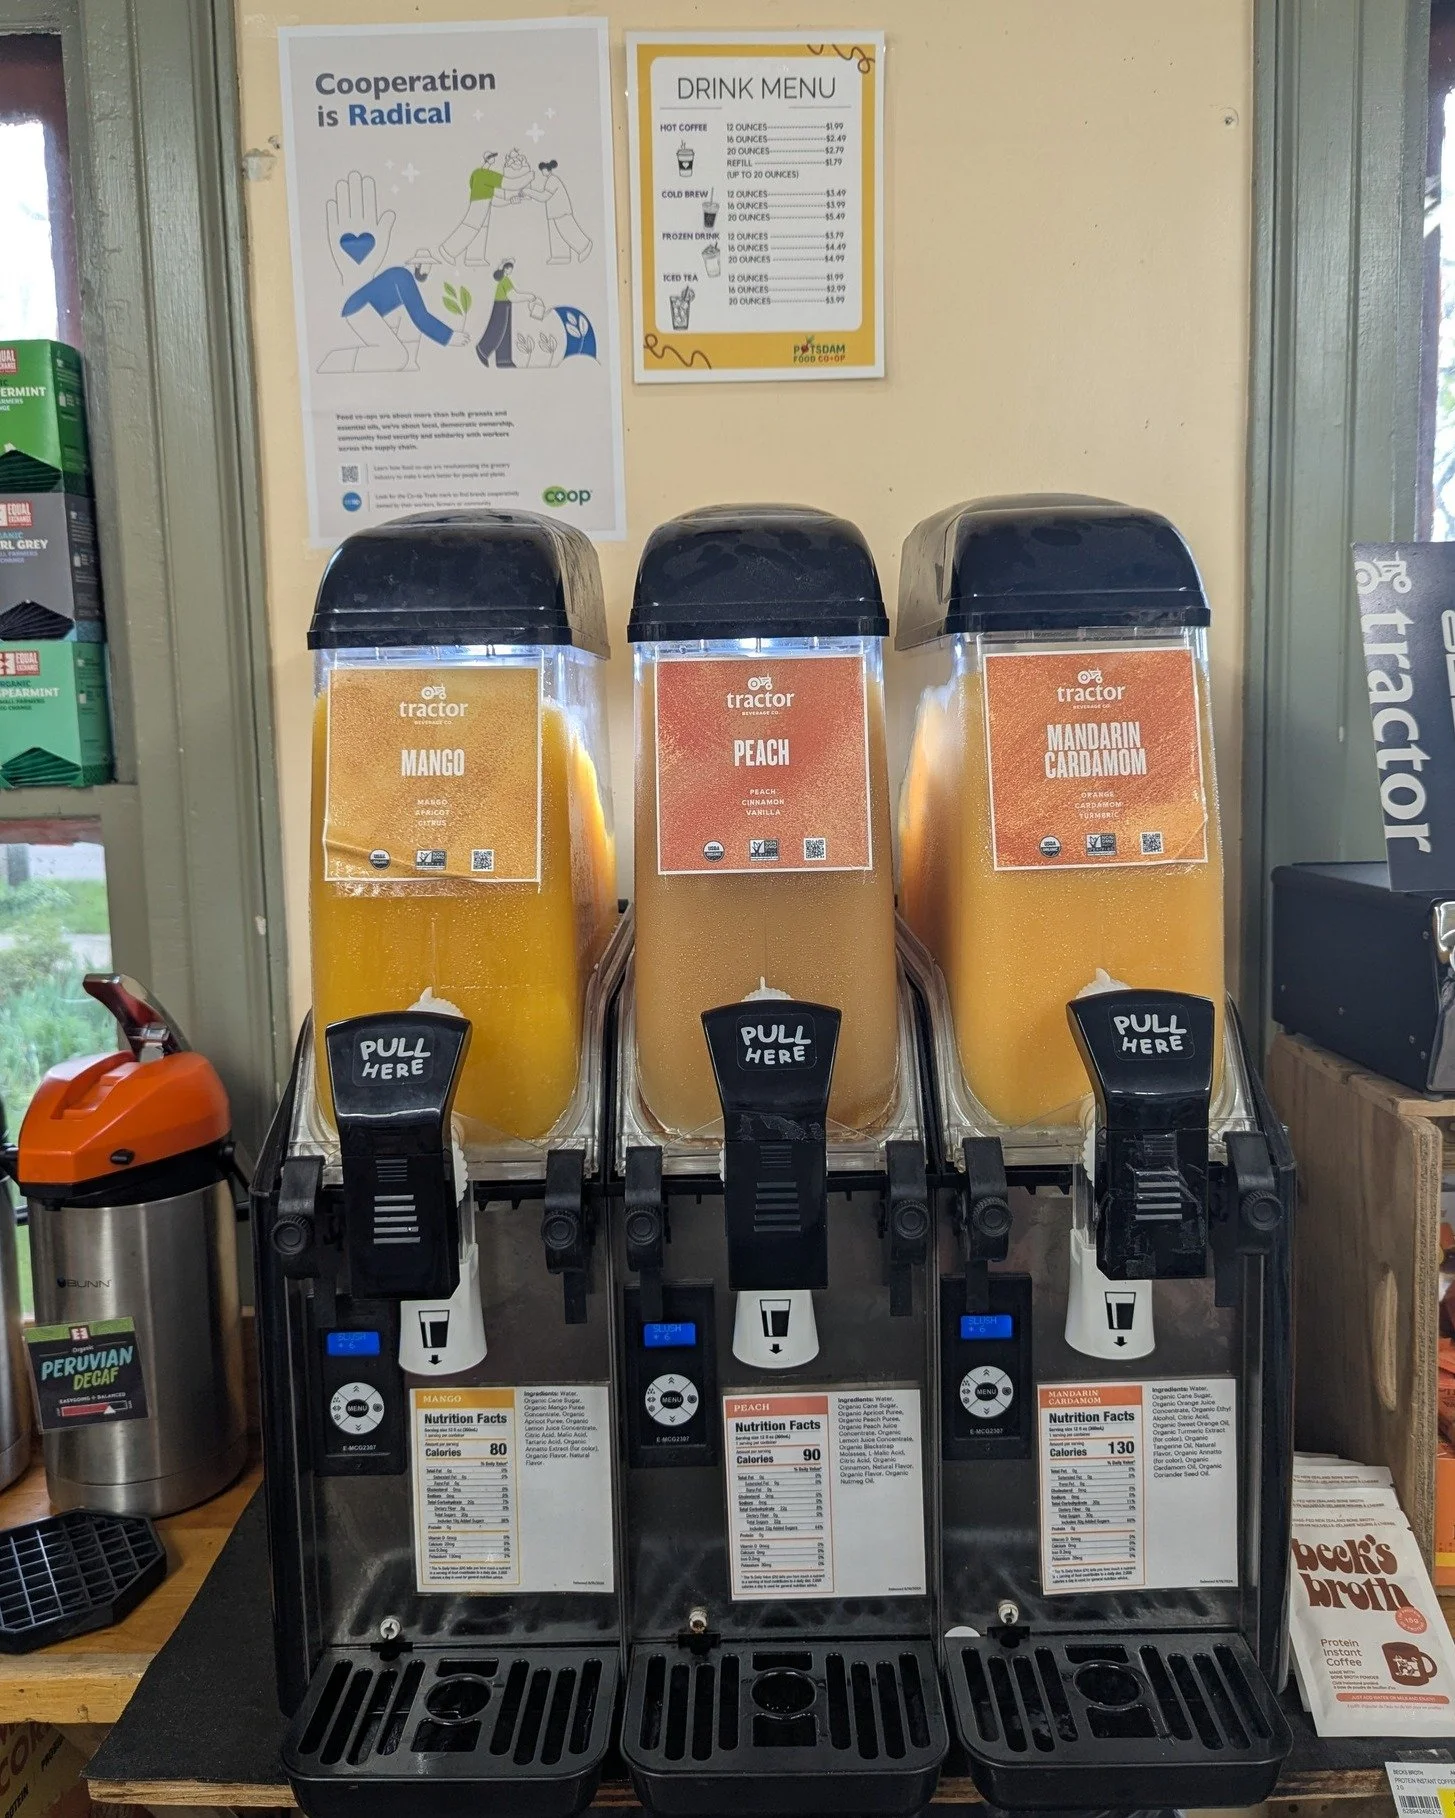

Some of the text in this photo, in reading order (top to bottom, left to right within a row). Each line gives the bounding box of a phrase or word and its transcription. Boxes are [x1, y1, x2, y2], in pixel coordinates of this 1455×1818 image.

[316, 68, 496, 100] Cooperation
[678, 77, 836, 99] DRINK MENU
[318, 102, 452, 126] is Radical
[660, 124, 677, 132] HOT
[736, 123, 767, 131] OUNCES
[826, 122, 844, 130] $1.99
[738, 147, 769, 155] OUNCES
[825, 146, 844, 154] $2.79
[754, 171, 763, 179] 20
[765, 171, 799, 179] OUNCES)
[685, 190, 708, 198] BREW
[727, 190, 734, 198] 12
[736, 190, 768, 198] OUNCES
[728, 201, 846, 210] 16 OUNCES $3.99
[728, 214, 737, 222] 20
[695, 232, 720, 240] DRINK
[728, 244, 735, 252] 16
[737, 244, 768, 252] OUNCES
[825, 255, 844, 263] $4.99
[737, 274, 768, 282] OUNCES
[728, 286, 736, 294] 16
[737, 286, 768, 294] OUNCES
[729, 298, 738, 306] 20
[0, 386, 46, 397] ERMINT
[544, 490, 591, 506] coop
[7, 502, 31, 516] EQUAL
[0, 539, 48, 550] RL GREY
[16, 652, 38, 664] EQUAL
[727, 691, 795, 709] tractor
[1057, 685, 1125, 703] tractor
[400, 701, 468, 717] tractor
[1047, 722, 1140, 750] MANDARIN
[1361, 608, 1432, 854] tractor
[734, 738, 789, 766] PEACH
[401, 749, 465, 777] MANGO
[1044, 748, 1147, 778] CARDAMOM
[1113, 1014, 1187, 1035] PULL
[741, 1024, 811, 1046] PULL
[360, 1038, 431, 1060] PULL
[1122, 1035, 1184, 1054] HERE
[745, 1046, 805, 1065] HERE
[362, 1059, 424, 1080] HERE
[67, 1279, 110, 1288] BUNN
[653, 1324, 681, 1333] SLUSH
[72, 1345, 94, 1353] Organic
[42, 1346, 133, 1380] PERUVIAN
[74, 1366, 120, 1390] DECAF
[1049, 1397, 1101, 1405] CARDAMOM
[734, 1404, 770, 1412] PEACH
[425, 1413, 507, 1424] Nutrition Facts
[1049, 1411, 1135, 1424] Nutrition Facts
[735, 1420, 820, 1432] Nutrition Facts
[426, 1443, 507, 1456] Calories 80
[1050, 1441, 1134, 1457] Calories 130
[737, 1448, 820, 1464] Calories 90
[1291, 1534, 1398, 1575] beck's
[1299, 1573, 1414, 1611] broth
[1321, 1639, 1359, 1647] Protein
[1327, 1658, 1362, 1666] Coffee
